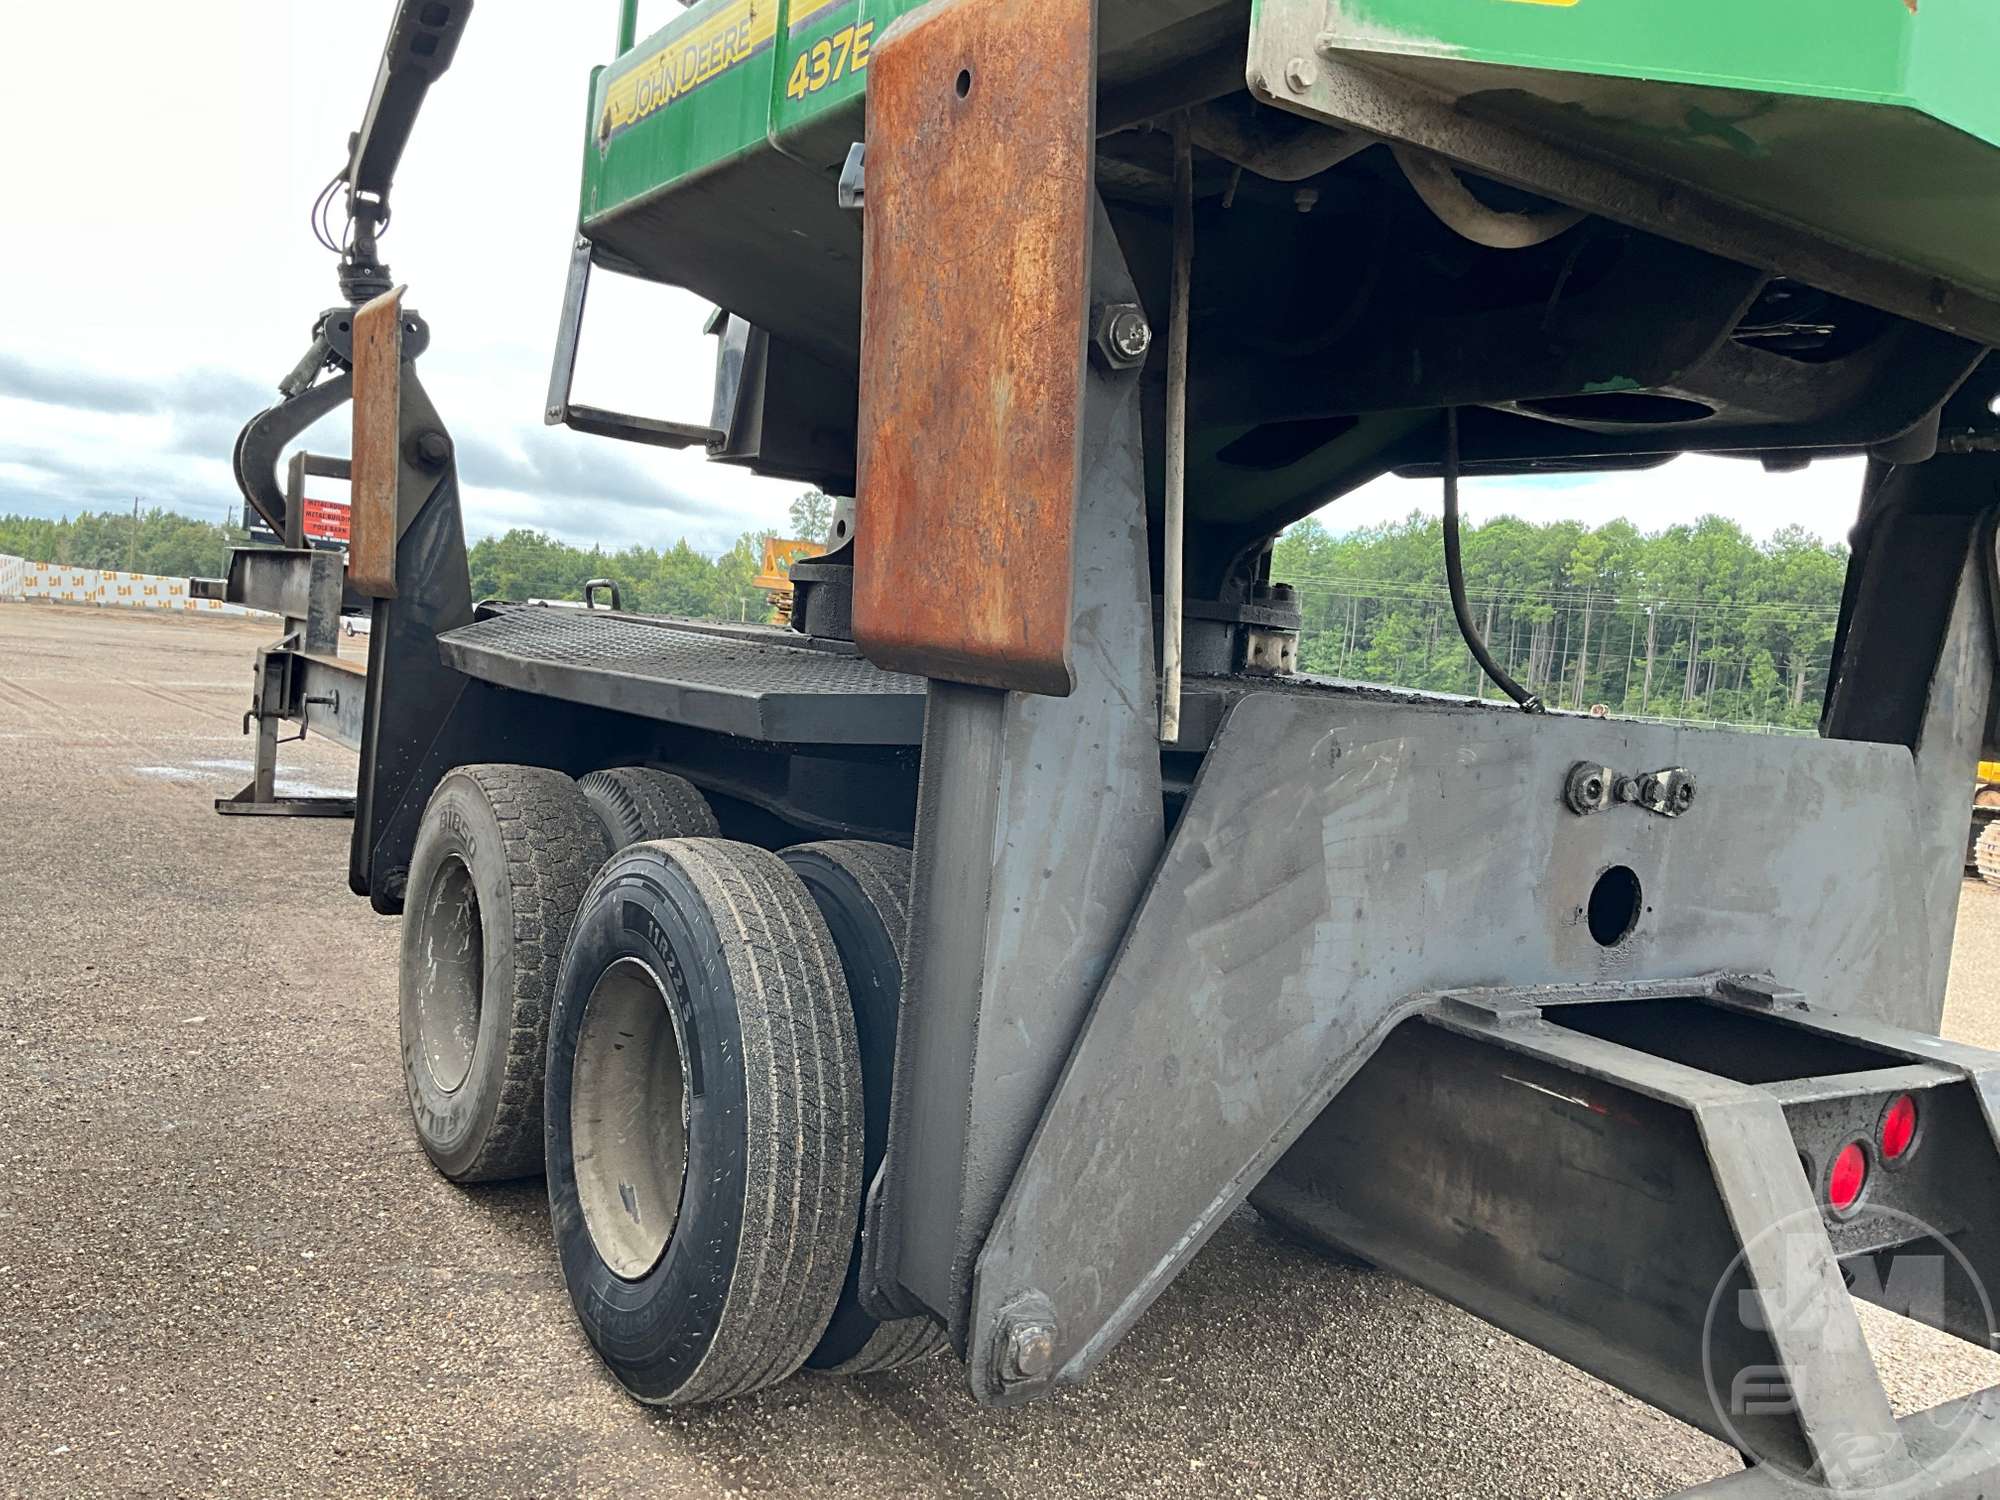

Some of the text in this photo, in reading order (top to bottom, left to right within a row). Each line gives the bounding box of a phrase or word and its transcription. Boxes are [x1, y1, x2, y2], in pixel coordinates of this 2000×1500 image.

[625, 18, 752, 124] JOHN DEERE
[786, 17, 876, 101] 437E
[306, 511, 326, 519] METAL
[648, 920, 692, 1023] 11R22.5
